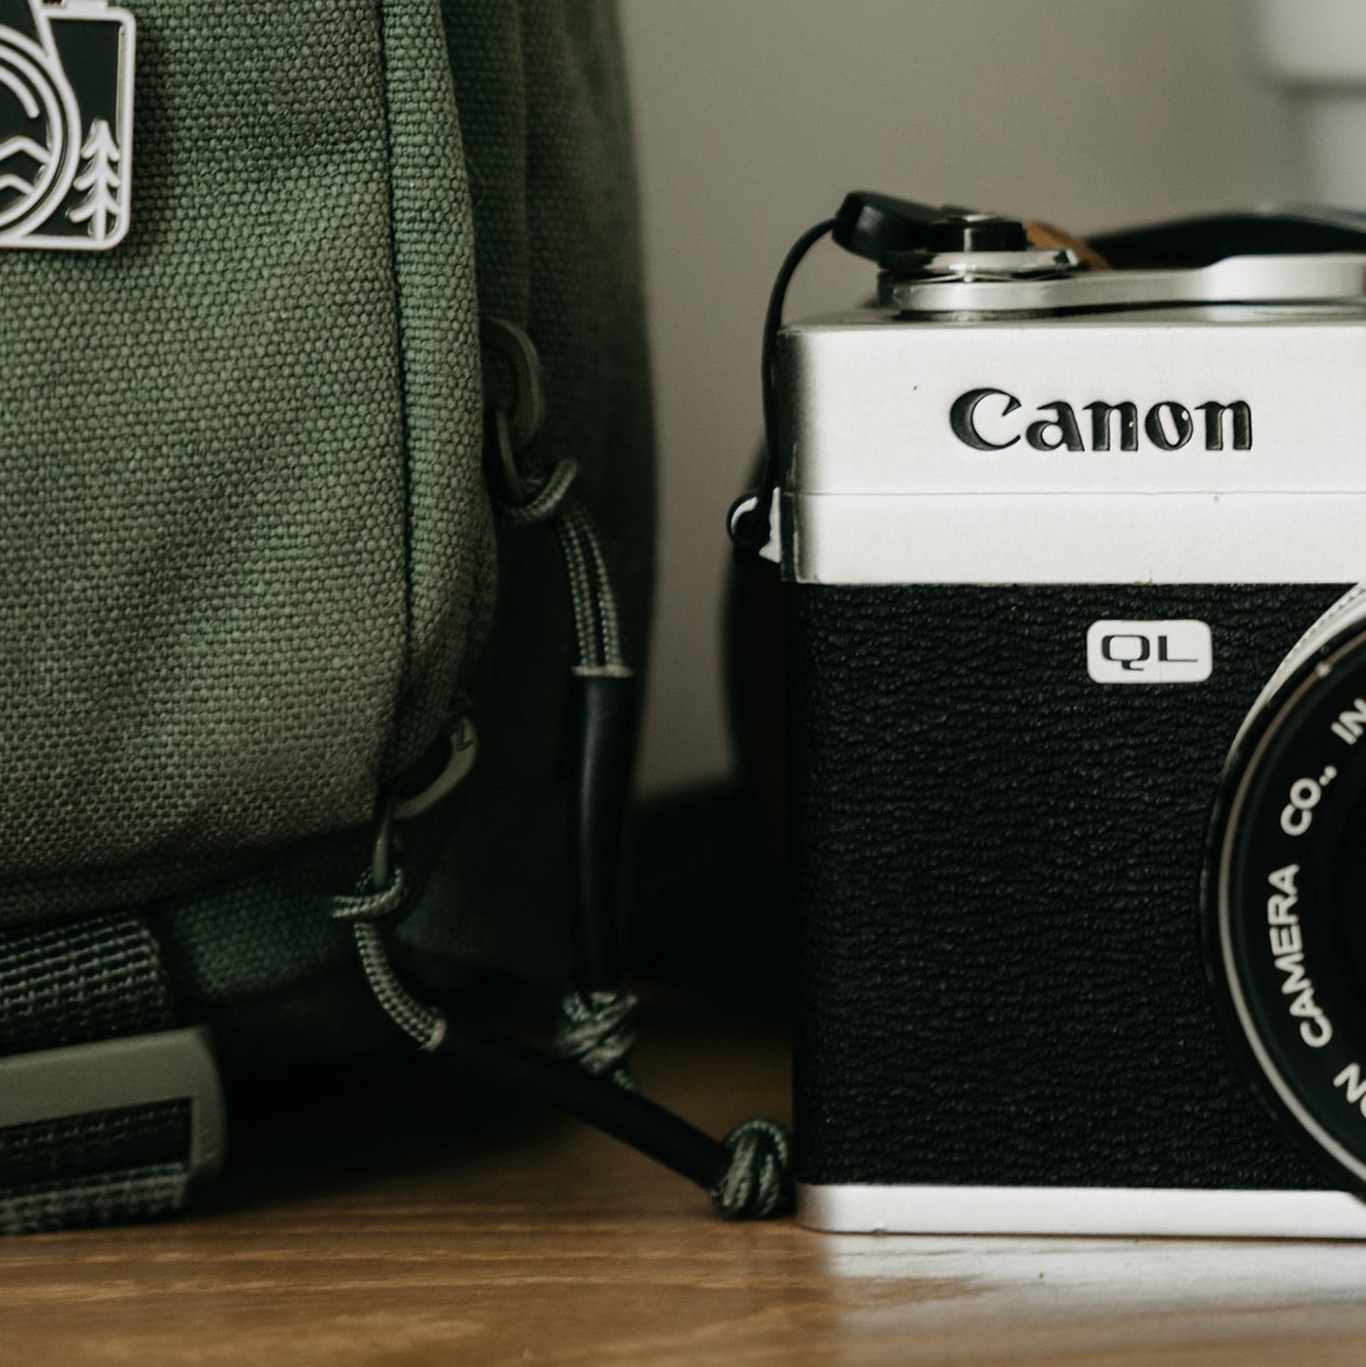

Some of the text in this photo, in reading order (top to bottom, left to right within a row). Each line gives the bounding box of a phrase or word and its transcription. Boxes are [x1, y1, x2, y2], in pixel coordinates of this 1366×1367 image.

[949, 387, 1252, 451] Canon
[1101, 634, 1198, 671] QL
[1266, 864, 1333, 1049] CAMERA
